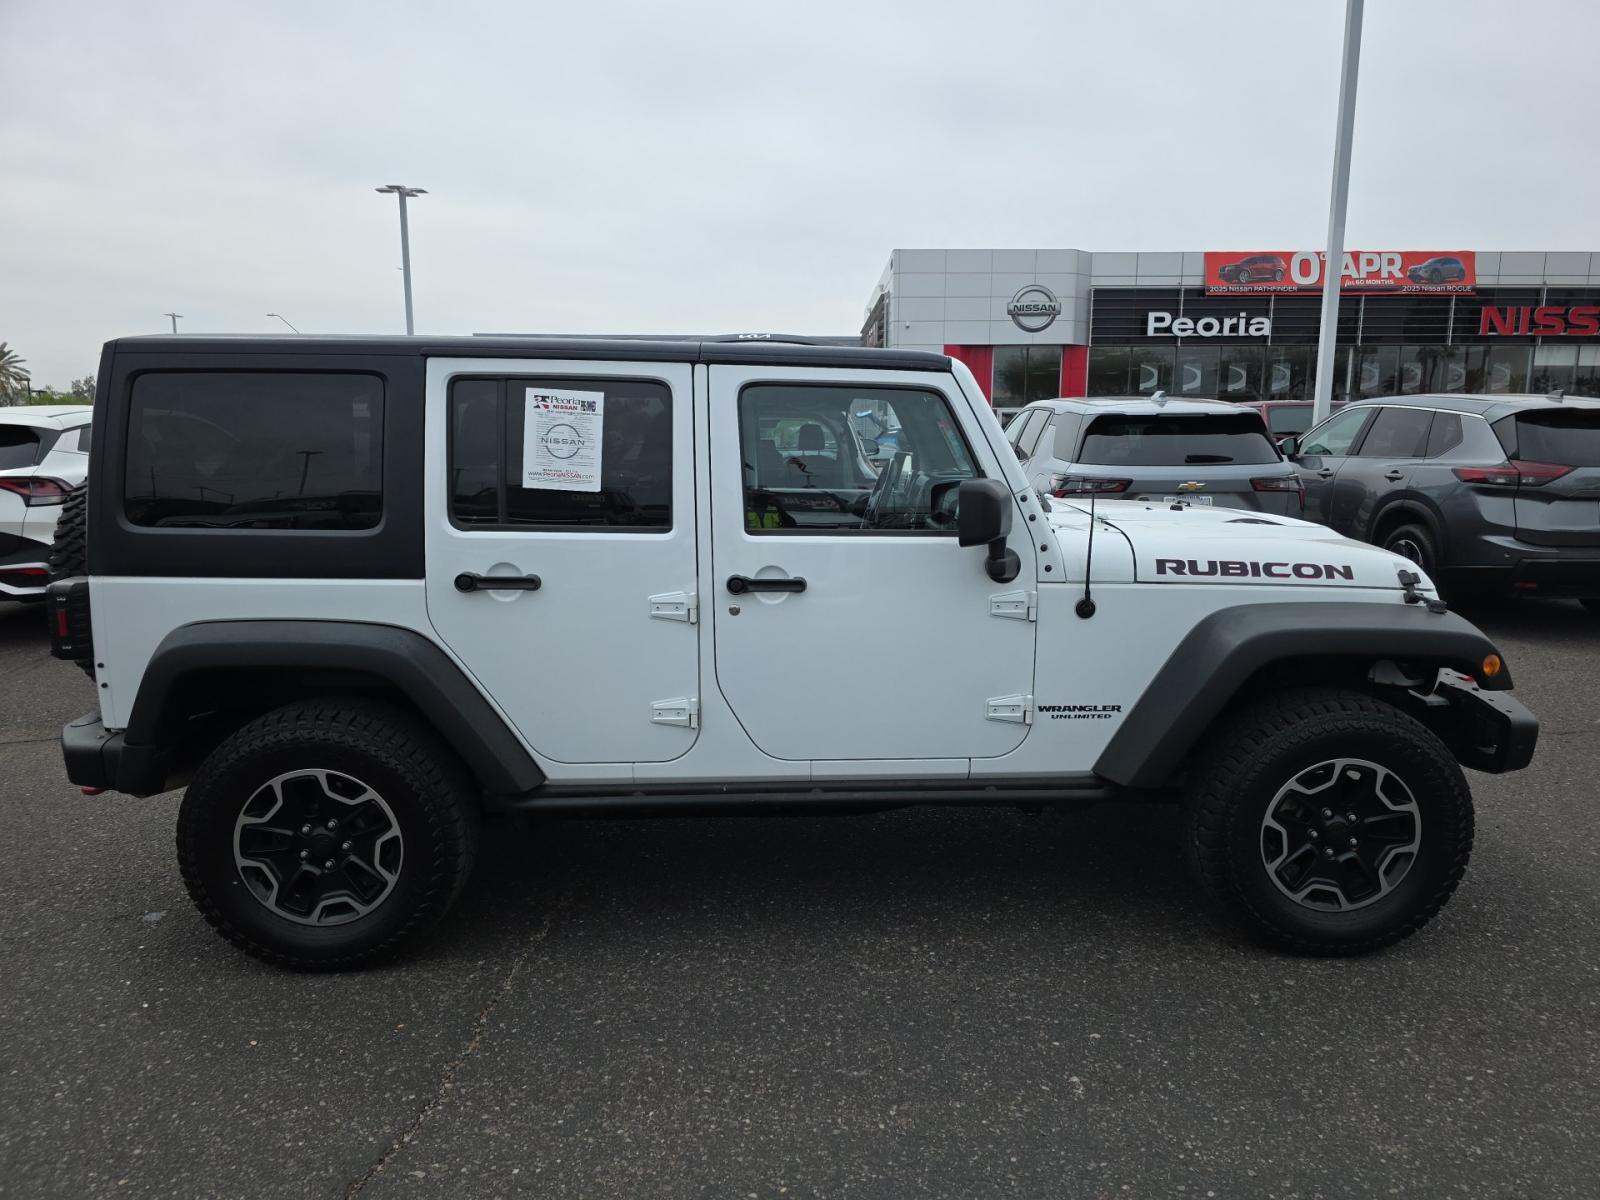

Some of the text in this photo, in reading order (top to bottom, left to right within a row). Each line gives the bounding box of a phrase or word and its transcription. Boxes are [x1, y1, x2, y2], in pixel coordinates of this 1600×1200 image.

[1341, 252, 1404, 279] APR
[1013, 304, 1056, 312] NISSAN
[1147, 311, 1271, 337] Peoria
[550, 395, 581, 406] Peoria
[541, 437, 585, 446] NISSAN
[1155, 558, 1355, 580] RUBICON
